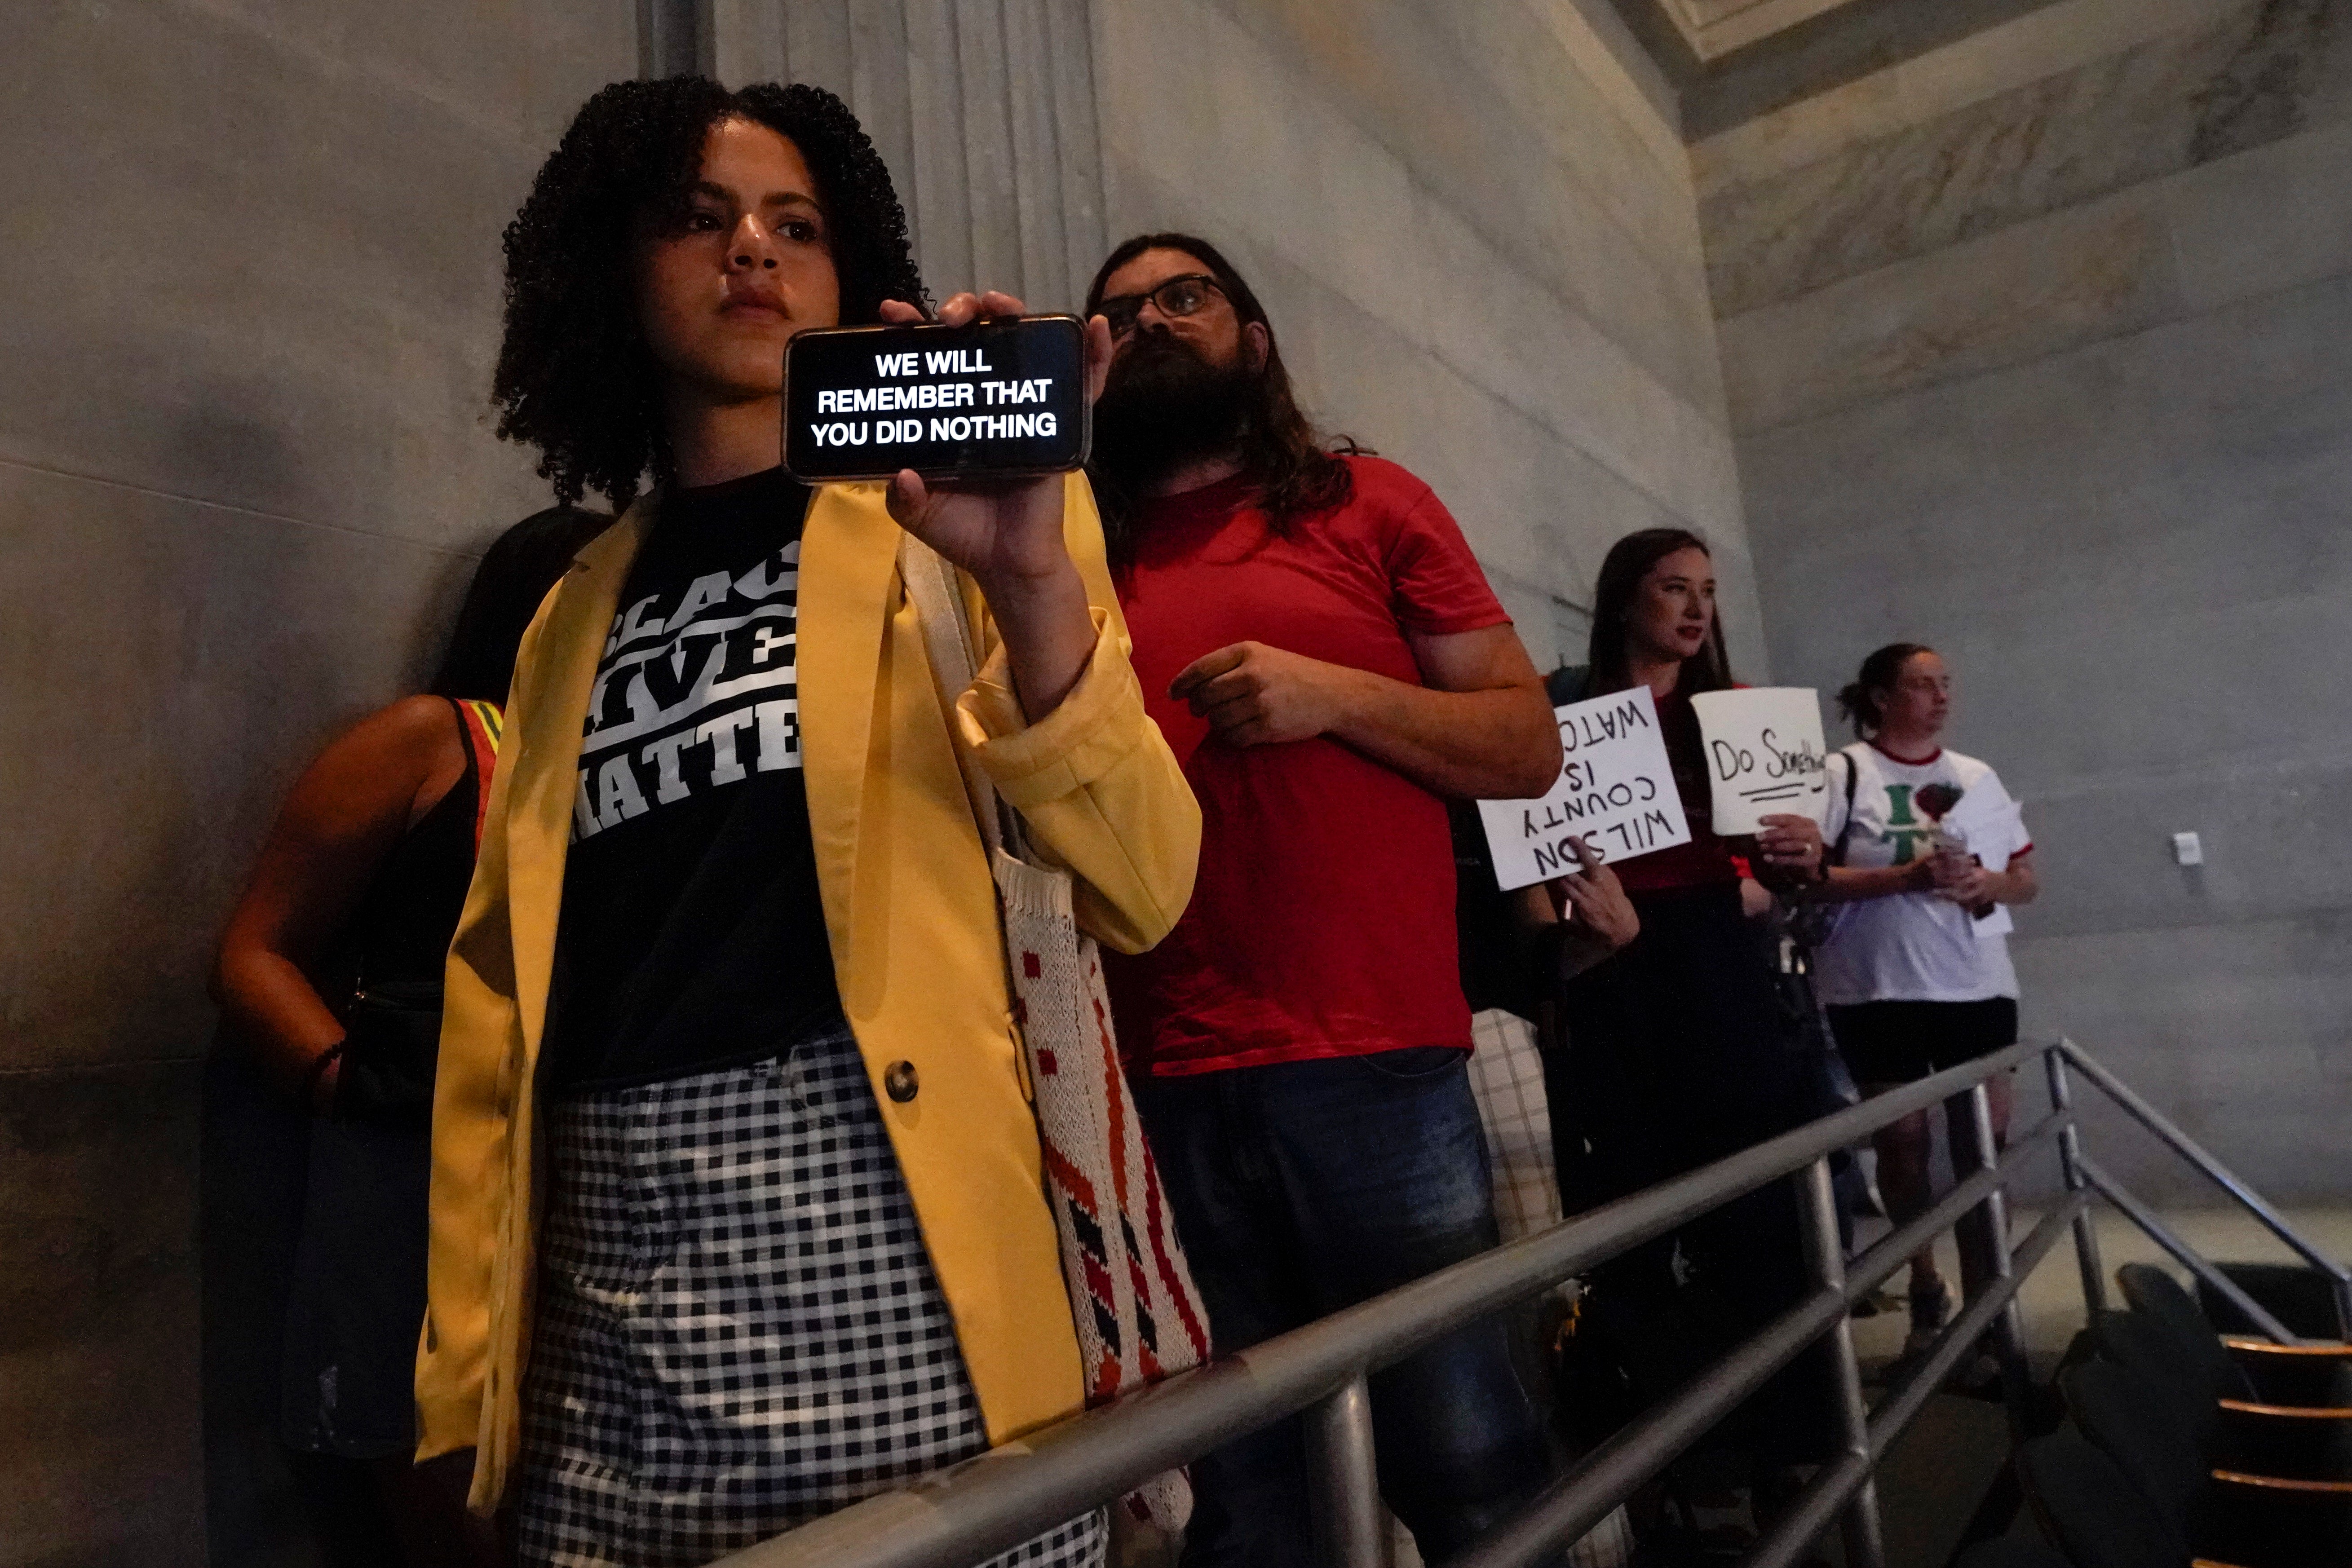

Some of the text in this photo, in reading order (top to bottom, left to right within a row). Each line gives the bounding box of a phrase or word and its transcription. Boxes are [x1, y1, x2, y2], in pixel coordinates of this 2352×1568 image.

[875, 349, 992, 377] WE WILL
[818, 378, 1052, 414] REMEMBER THAT
[810, 412, 1057, 446] YOU DID NOTHING
[603, 540, 800, 658] LAC
[583, 614, 797, 737] IVE
[1560, 700, 1649, 753] WATC
[569, 698, 804, 844] ATTE
[1565, 760, 1595, 792] IS
[1711, 739, 1755, 782] Do
[1524, 776, 1656, 839] COUNTY
[1533, 809, 1675, 876] WILSON
[1881, 830, 1928, 865] T
